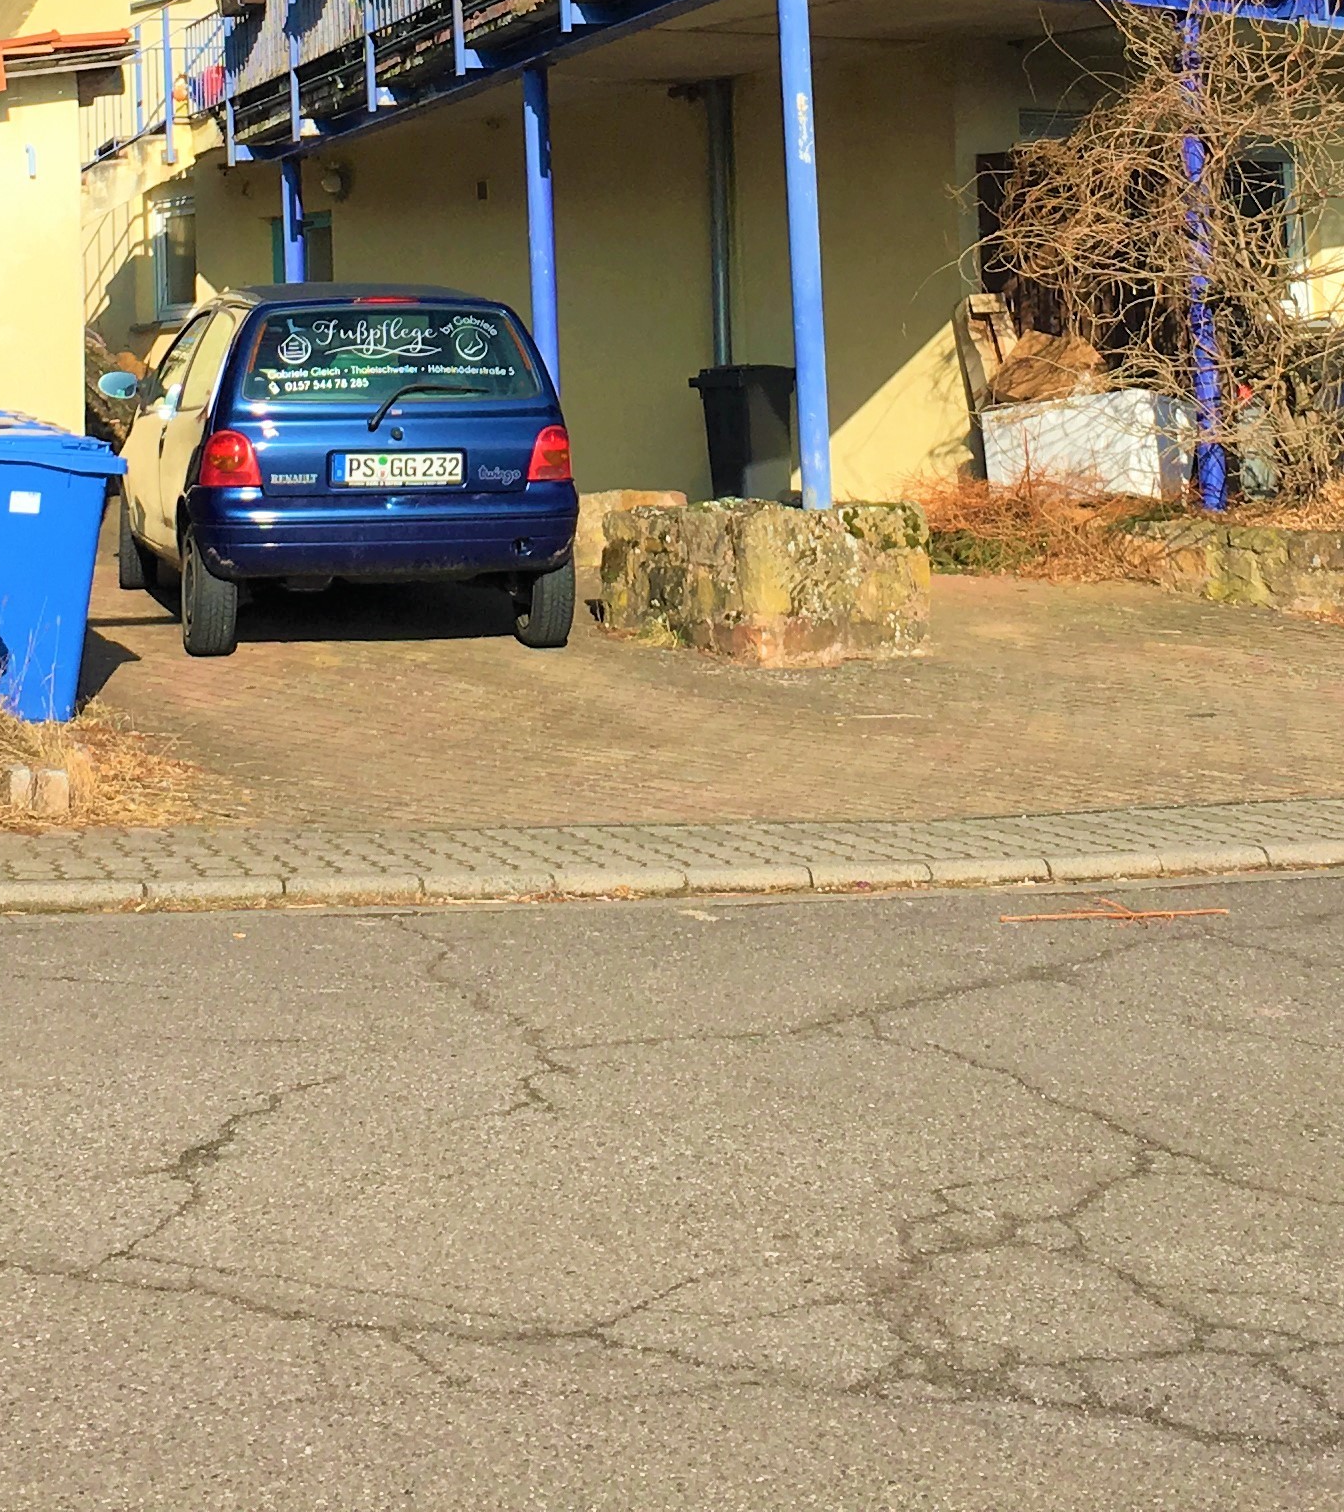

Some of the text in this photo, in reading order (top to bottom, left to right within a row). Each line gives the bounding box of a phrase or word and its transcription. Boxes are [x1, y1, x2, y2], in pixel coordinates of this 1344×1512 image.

[439, 315, 498, 337] by Gabriele
[312, 316, 438, 354] Fußpflege
[267, 368, 309, 380] Gabriele
[284, 380, 311, 392] 0157
[349, 456, 460, 477] PS GG 232
[270, 473, 318, 484] RENAULT
